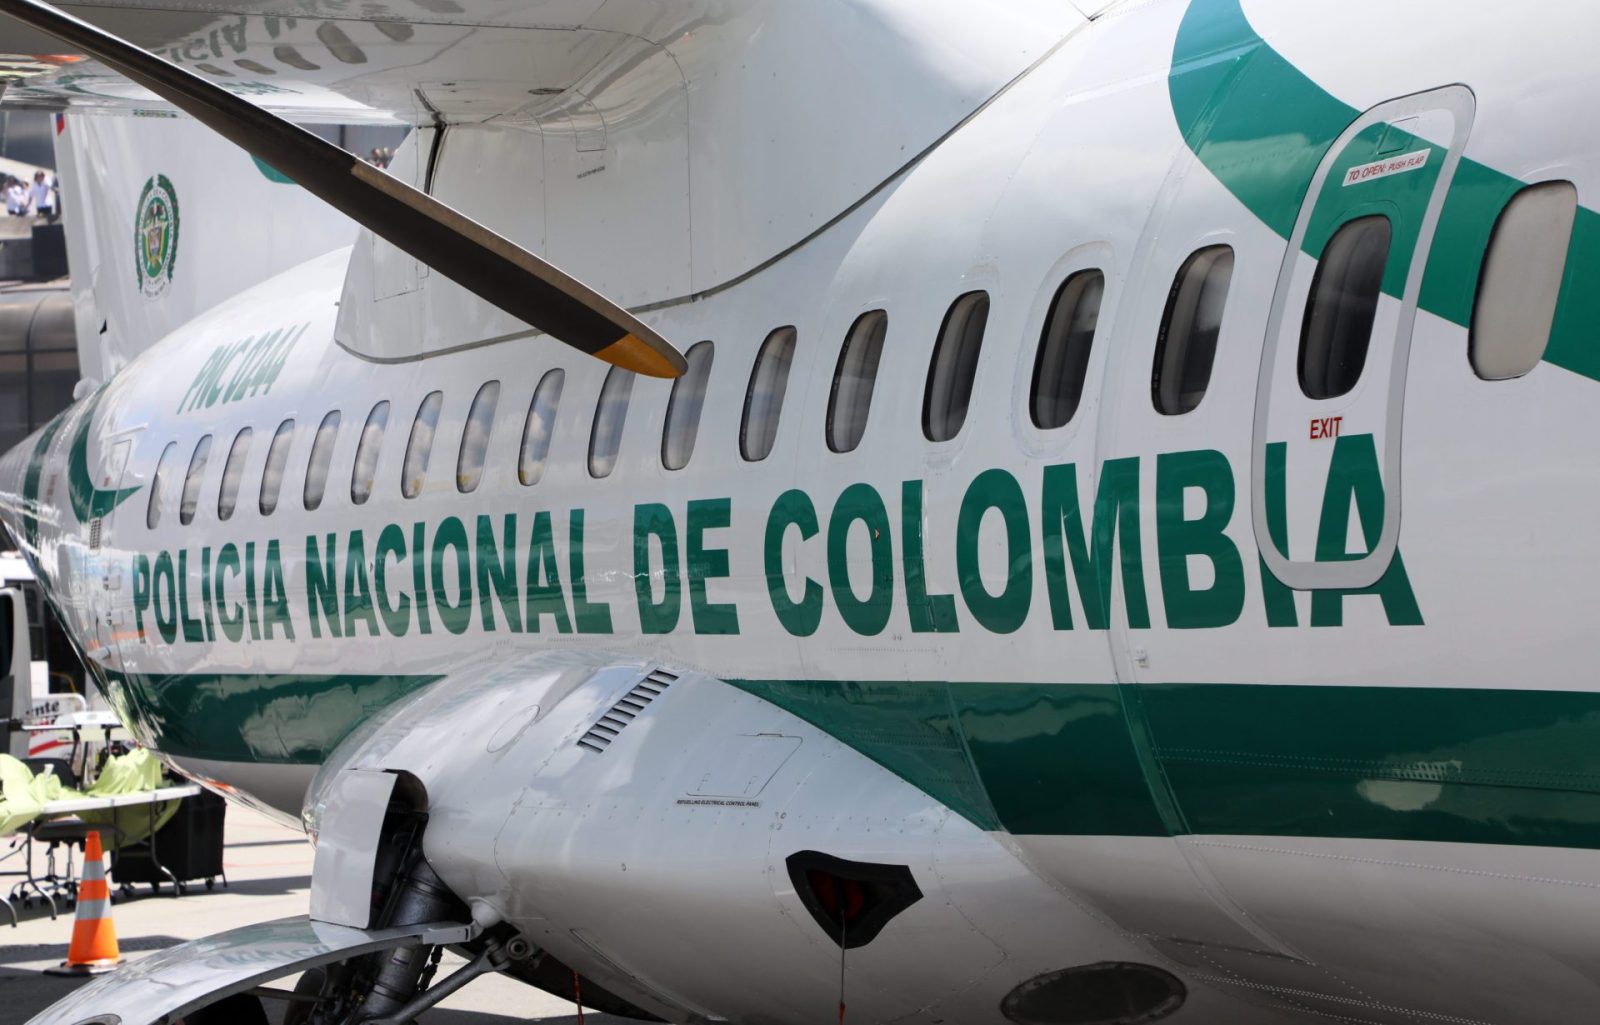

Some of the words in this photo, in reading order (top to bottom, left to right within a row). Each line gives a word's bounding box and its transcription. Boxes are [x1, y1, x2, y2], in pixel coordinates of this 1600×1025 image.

[1348, 169, 1360, 182] TO
[1388, 161, 1407, 172] PUSH
[1407, 155, 1425, 167] FLAP
[1309, 416, 1343, 440] EXIT
[134, 539, 295, 645] POLICIA
[305, 507, 613, 638] NACIONAL
[634, 496, 740, 636] DE
[764, 432, 1425, 637] COLOMBIA
